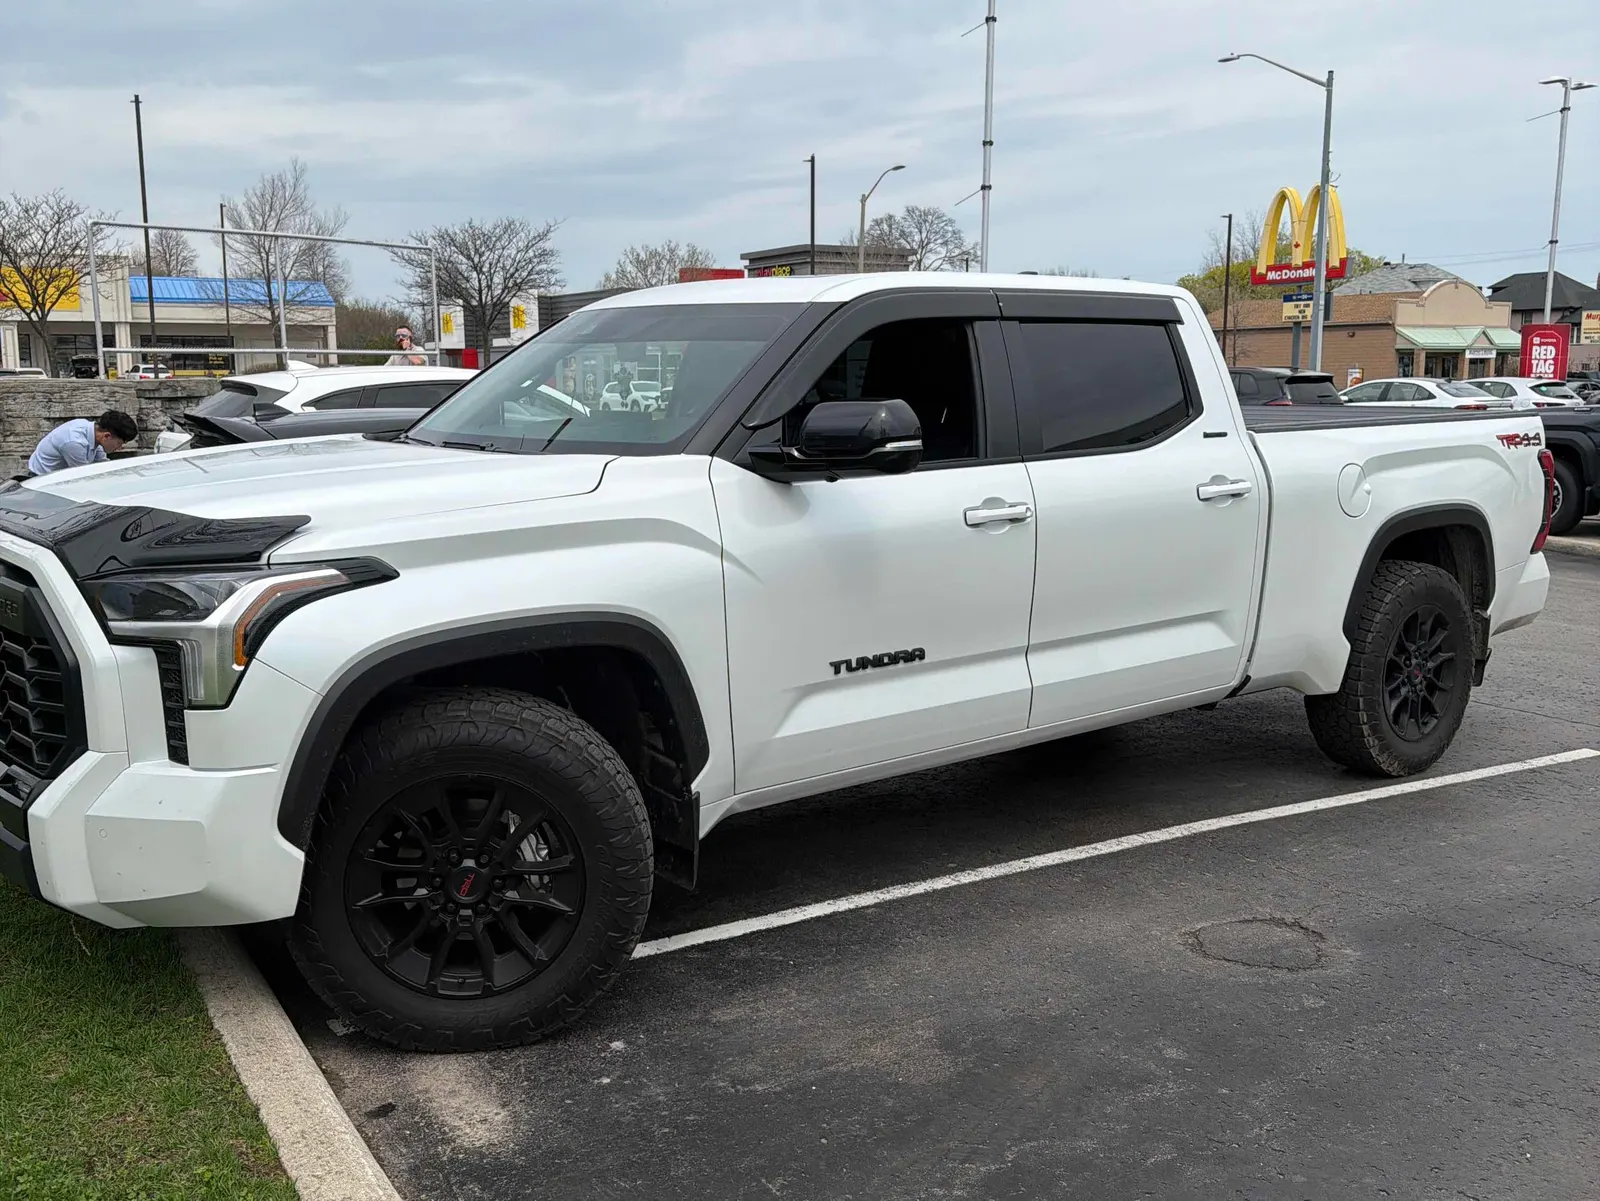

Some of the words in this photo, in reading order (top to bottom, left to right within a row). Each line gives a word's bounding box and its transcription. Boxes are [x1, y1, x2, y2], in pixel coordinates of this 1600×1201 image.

[1532, 345, 1556, 359] RED
[1531, 359, 1555, 373] TAG
[829, 647, 926, 675] TUNDRA
